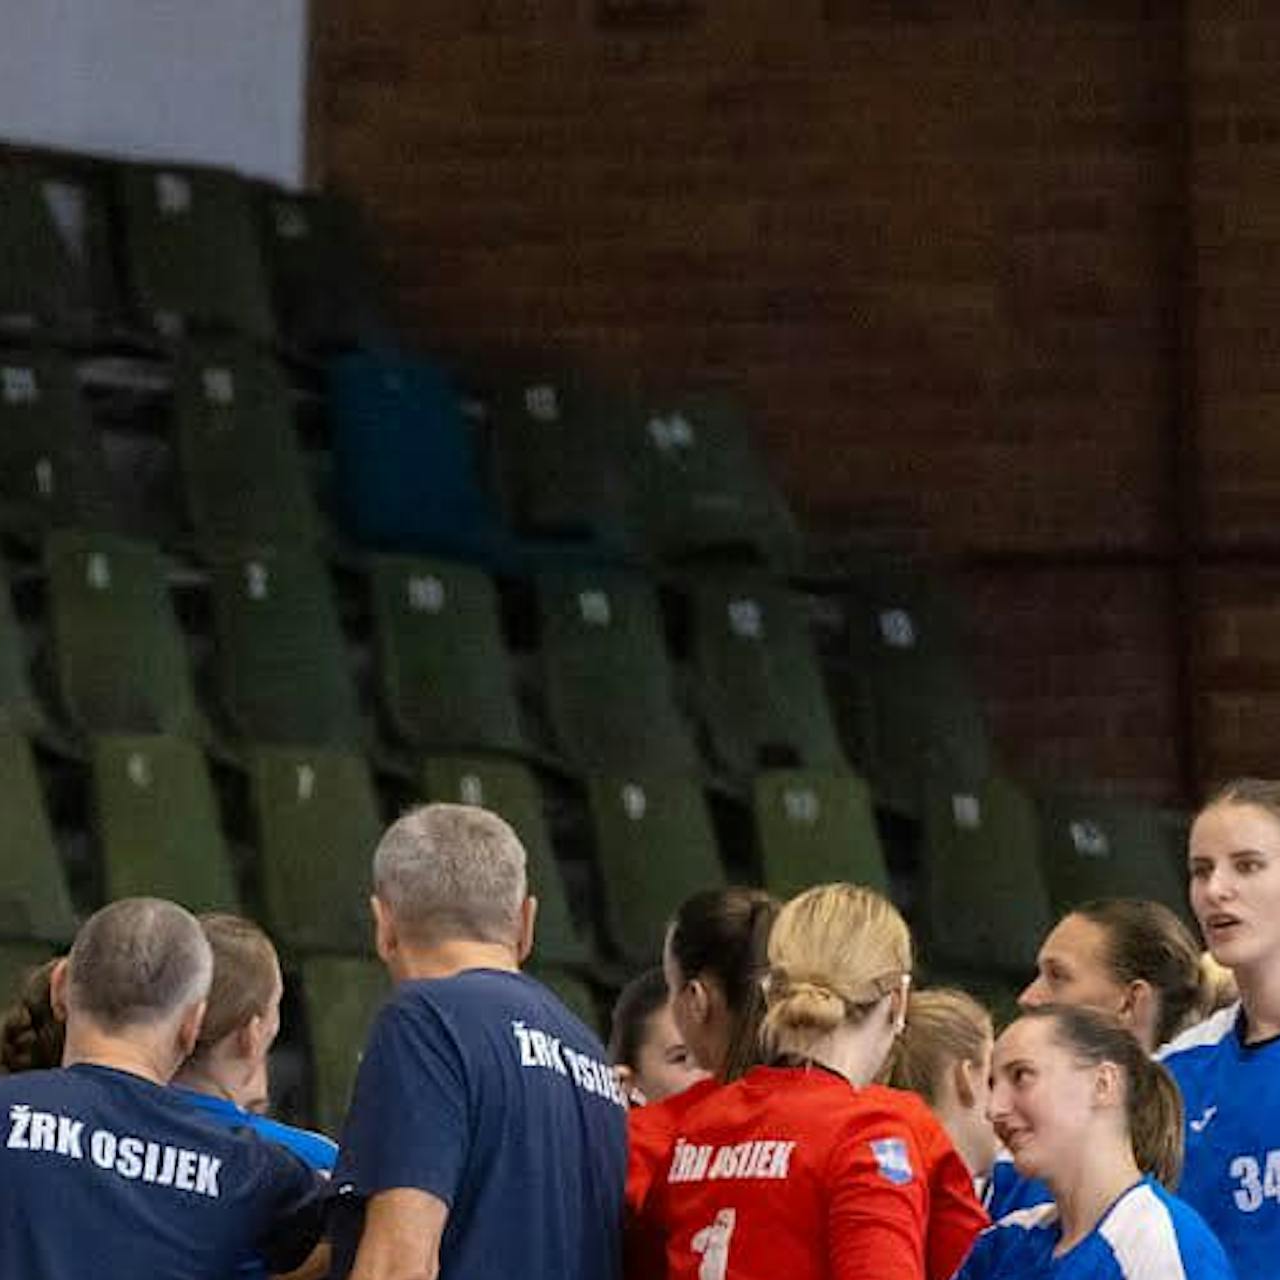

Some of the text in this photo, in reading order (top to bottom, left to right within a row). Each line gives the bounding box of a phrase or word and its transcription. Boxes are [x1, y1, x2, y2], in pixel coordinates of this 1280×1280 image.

[7, 1105, 222, 1199] ŽRK OSIJEK
[708, 1140, 797, 1181] OSIJEK
